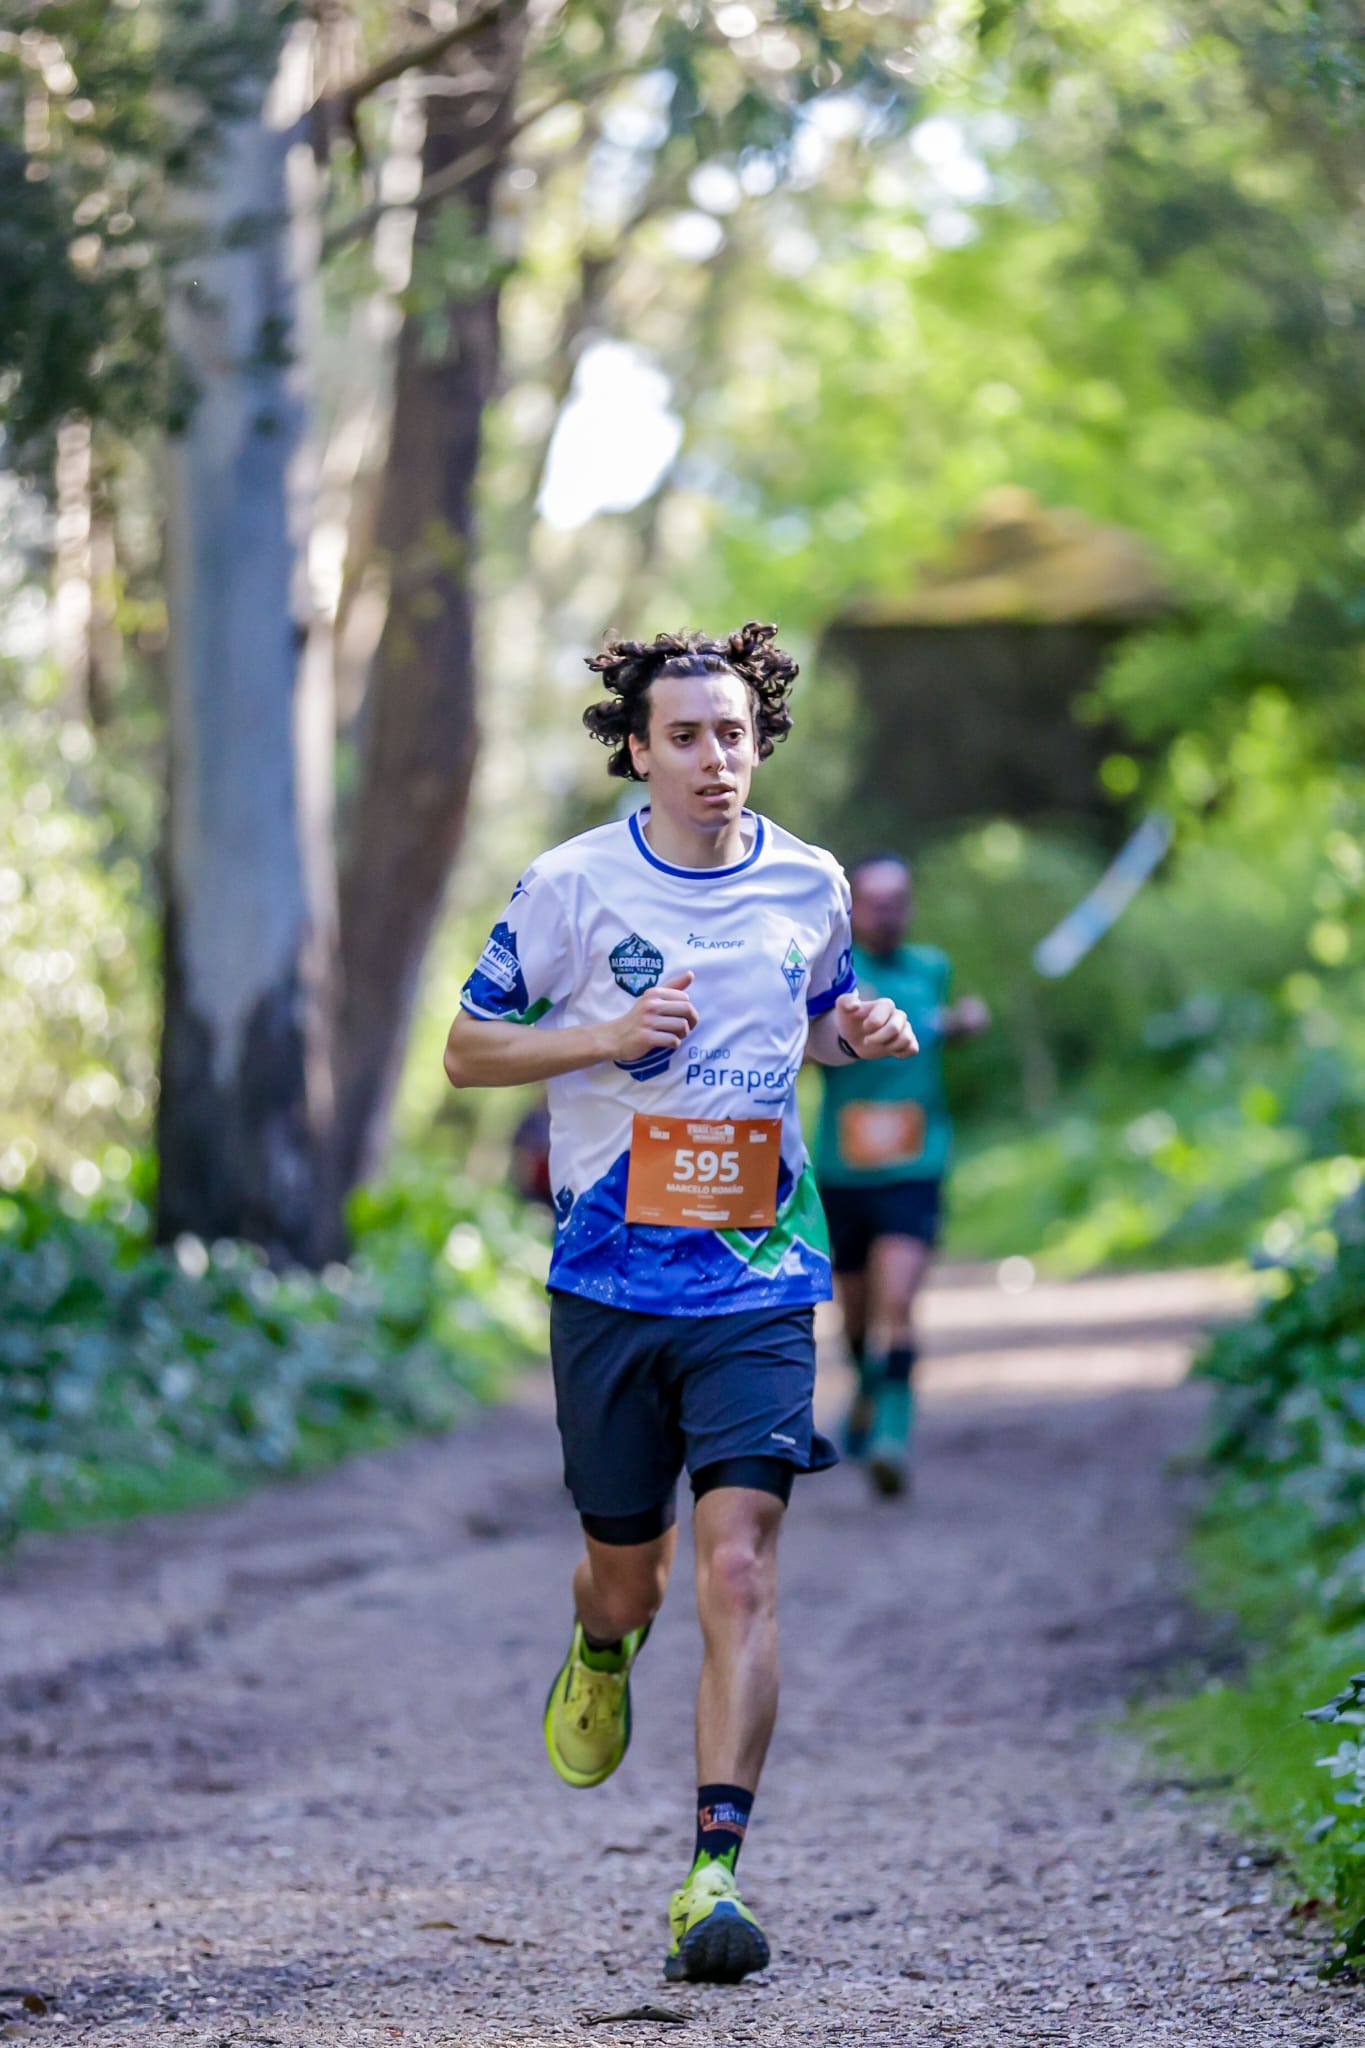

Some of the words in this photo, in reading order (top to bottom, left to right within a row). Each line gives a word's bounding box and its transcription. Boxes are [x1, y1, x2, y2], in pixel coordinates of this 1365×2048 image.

[694, 940, 745, 950] PLAYOFF
[611, 957, 662, 969] ALCOBERTAS
[688, 1046, 731, 1060] Grupo
[673, 1149, 740, 1183] 595
[666, 1183, 710, 1194] MARCELO
